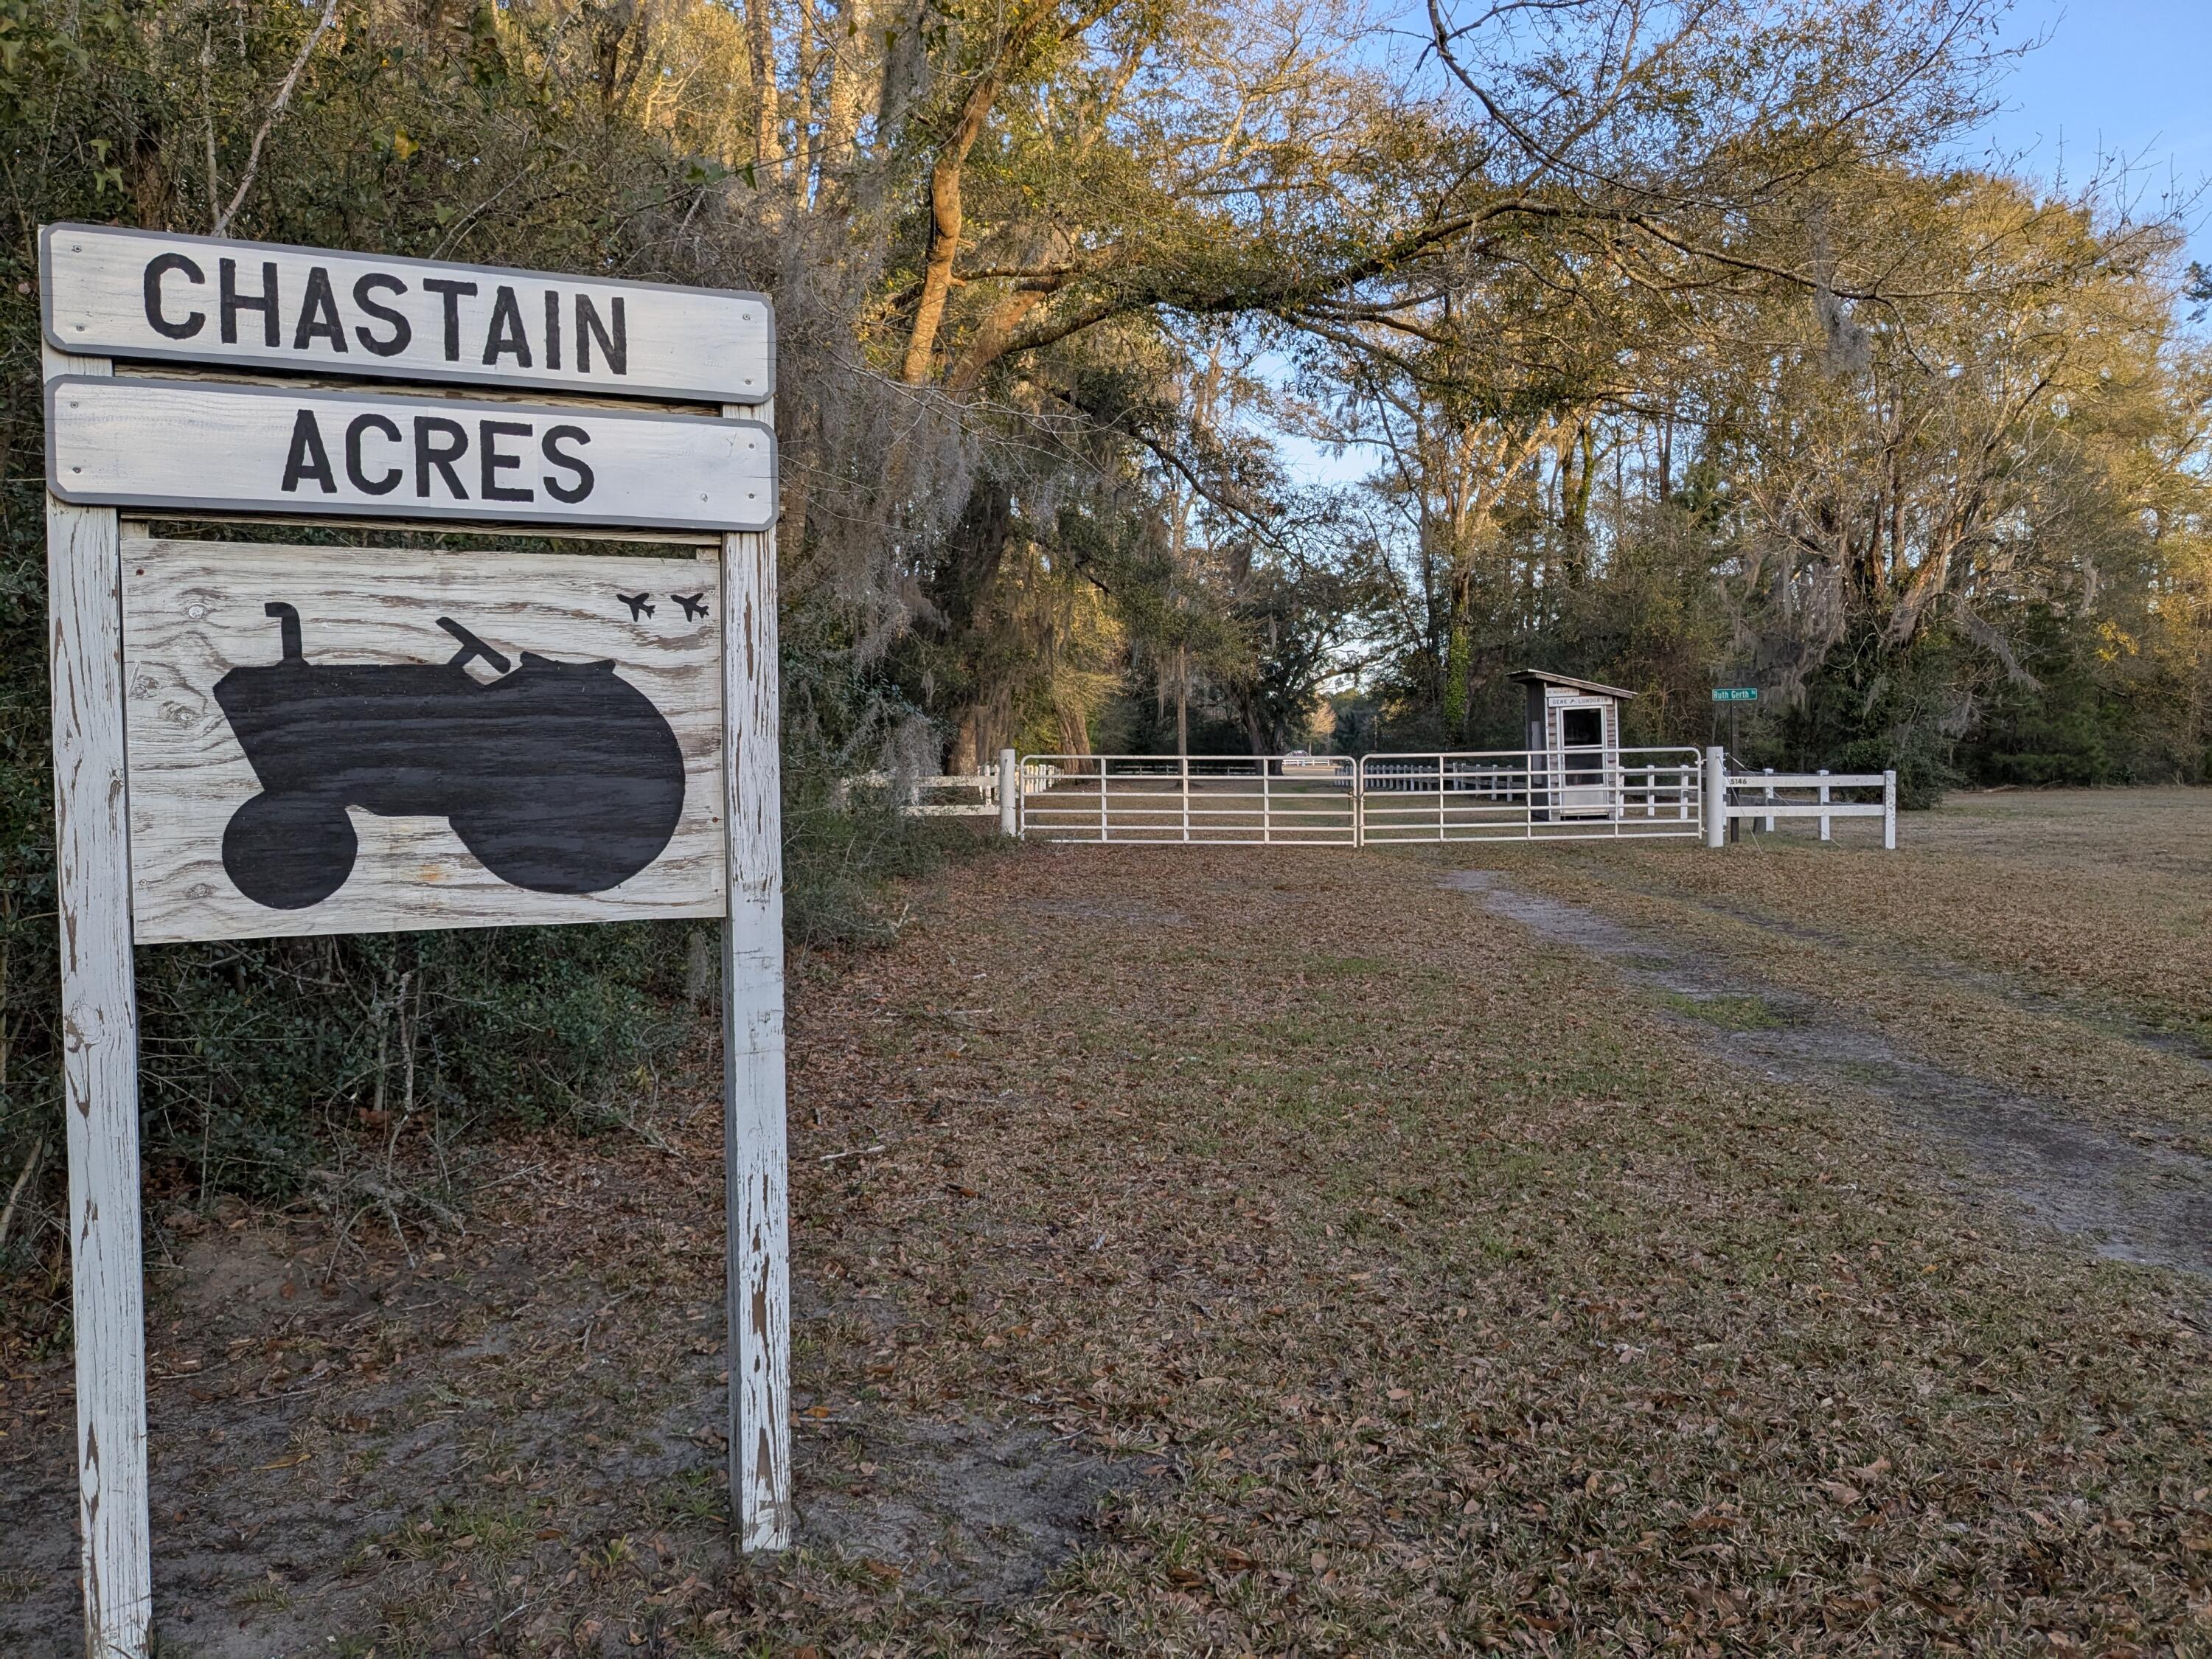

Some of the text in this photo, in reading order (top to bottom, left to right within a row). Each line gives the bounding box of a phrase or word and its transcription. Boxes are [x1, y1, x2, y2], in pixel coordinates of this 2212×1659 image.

[144, 252, 627, 375] CHASTAIN
[281, 408, 595, 504] ACRES
[1714, 691, 1729, 699] Ruth
[1731, 690, 1749, 698] Gerth
